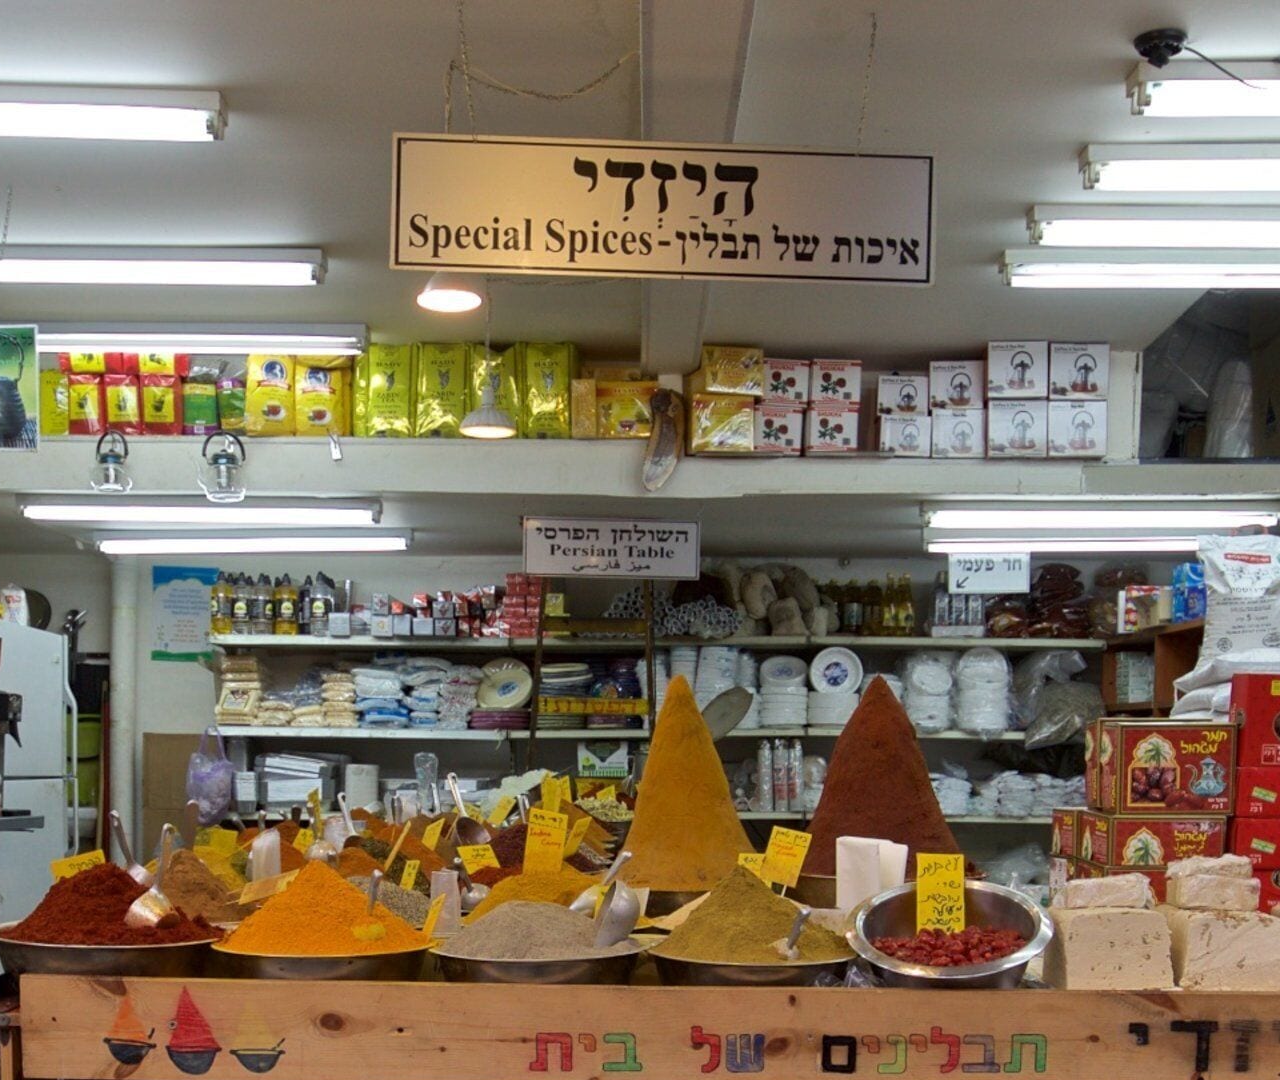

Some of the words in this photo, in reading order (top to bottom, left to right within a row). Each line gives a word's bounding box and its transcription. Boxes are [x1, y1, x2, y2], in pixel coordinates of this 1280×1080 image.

[408, 213, 533, 257] Special
[674, 222, 761, 265] תבלין
[771, 223, 819, 262] של
[831, 235, 920, 266] איכות
[536, 526, 600, 541] הפרסי
[610, 524, 689, 545] השולחן
[550, 544, 618, 558] Persian
[623, 546, 675, 559] Table
[956, 557, 995, 573] פעמי
[1003, 559, 1023, 571] חד
[529, 1031, 642, 1074] בית
[690, 1025, 766, 1074] של
[821, 1026, 1049, 1075] תבלינים
